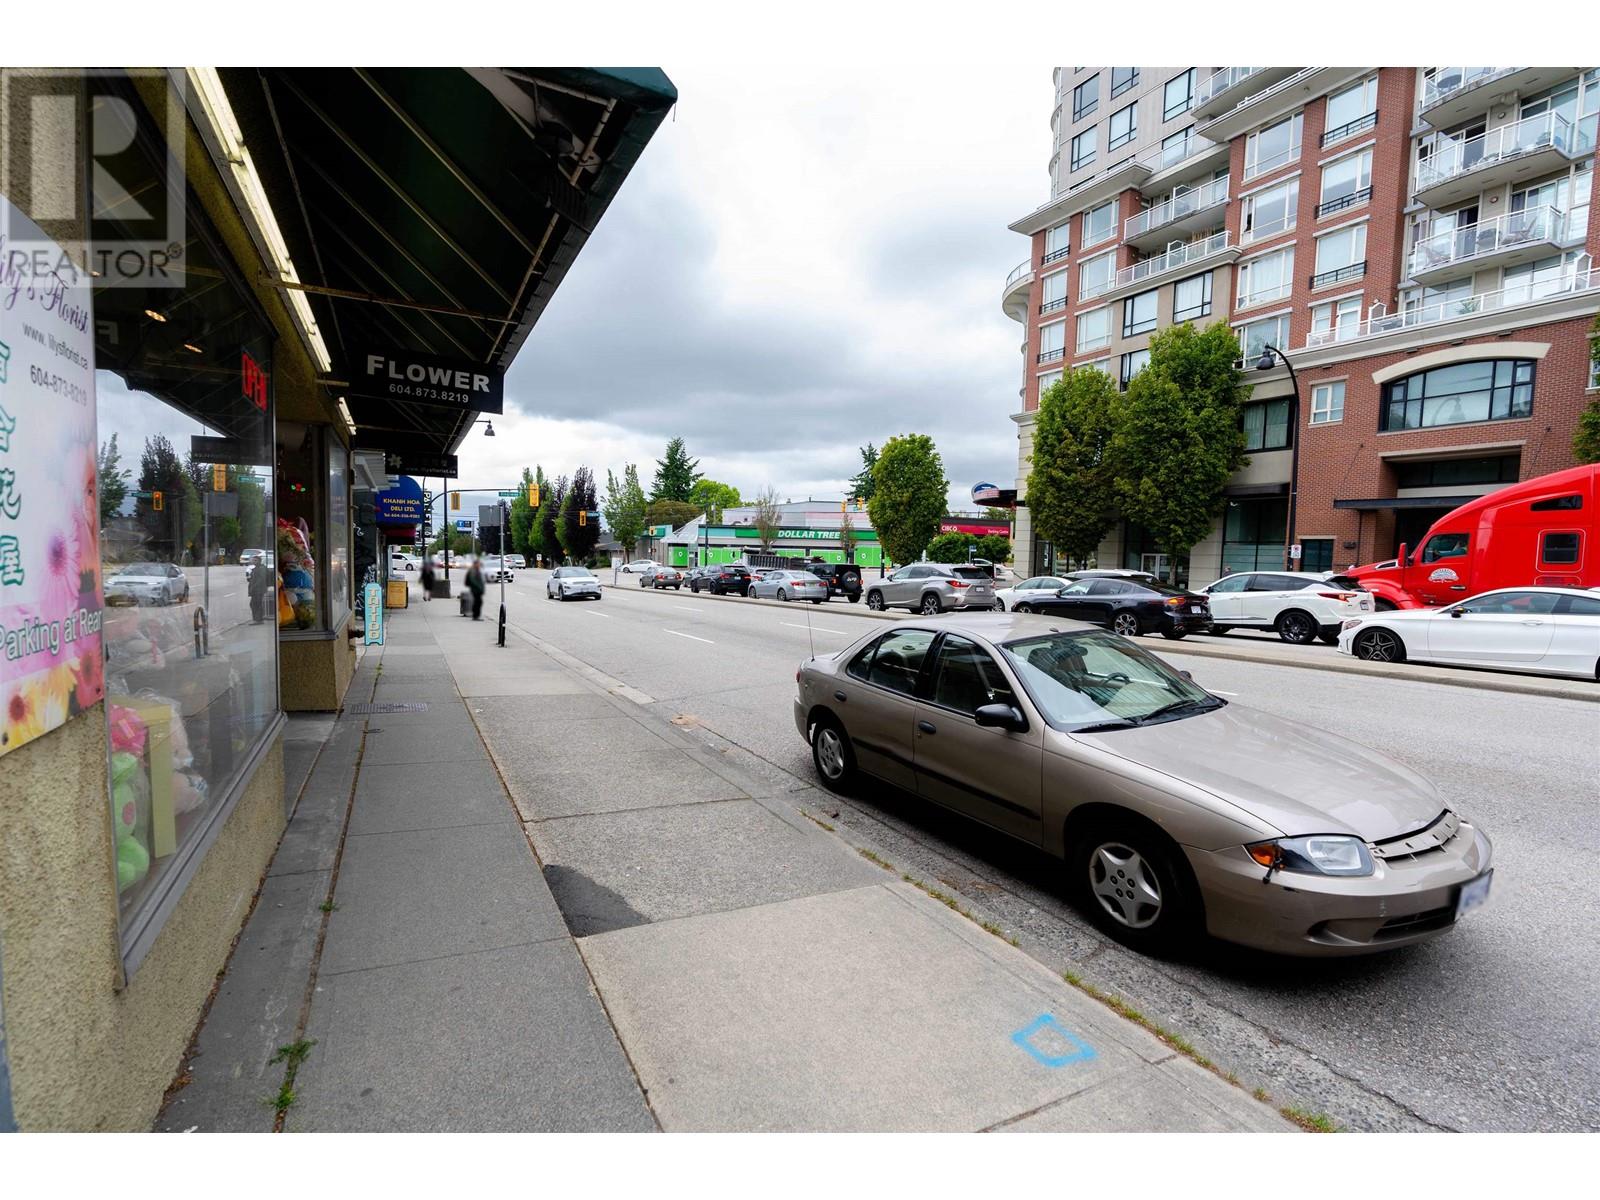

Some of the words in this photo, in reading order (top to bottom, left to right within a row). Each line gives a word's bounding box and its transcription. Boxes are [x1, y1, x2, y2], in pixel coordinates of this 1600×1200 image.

[40, 271, 88, 333] Florist
[367, 354, 490, 393] FLOWER
[389, 383, 469, 403] 604.873.8219
[778, 530, 815, 539] DOLLAR
[817, 531, 841, 539] TREE
[64, 614, 77, 644] at
[79, 607, 102, 637] Rear
[368, 589, 380, 640] TATTOO
